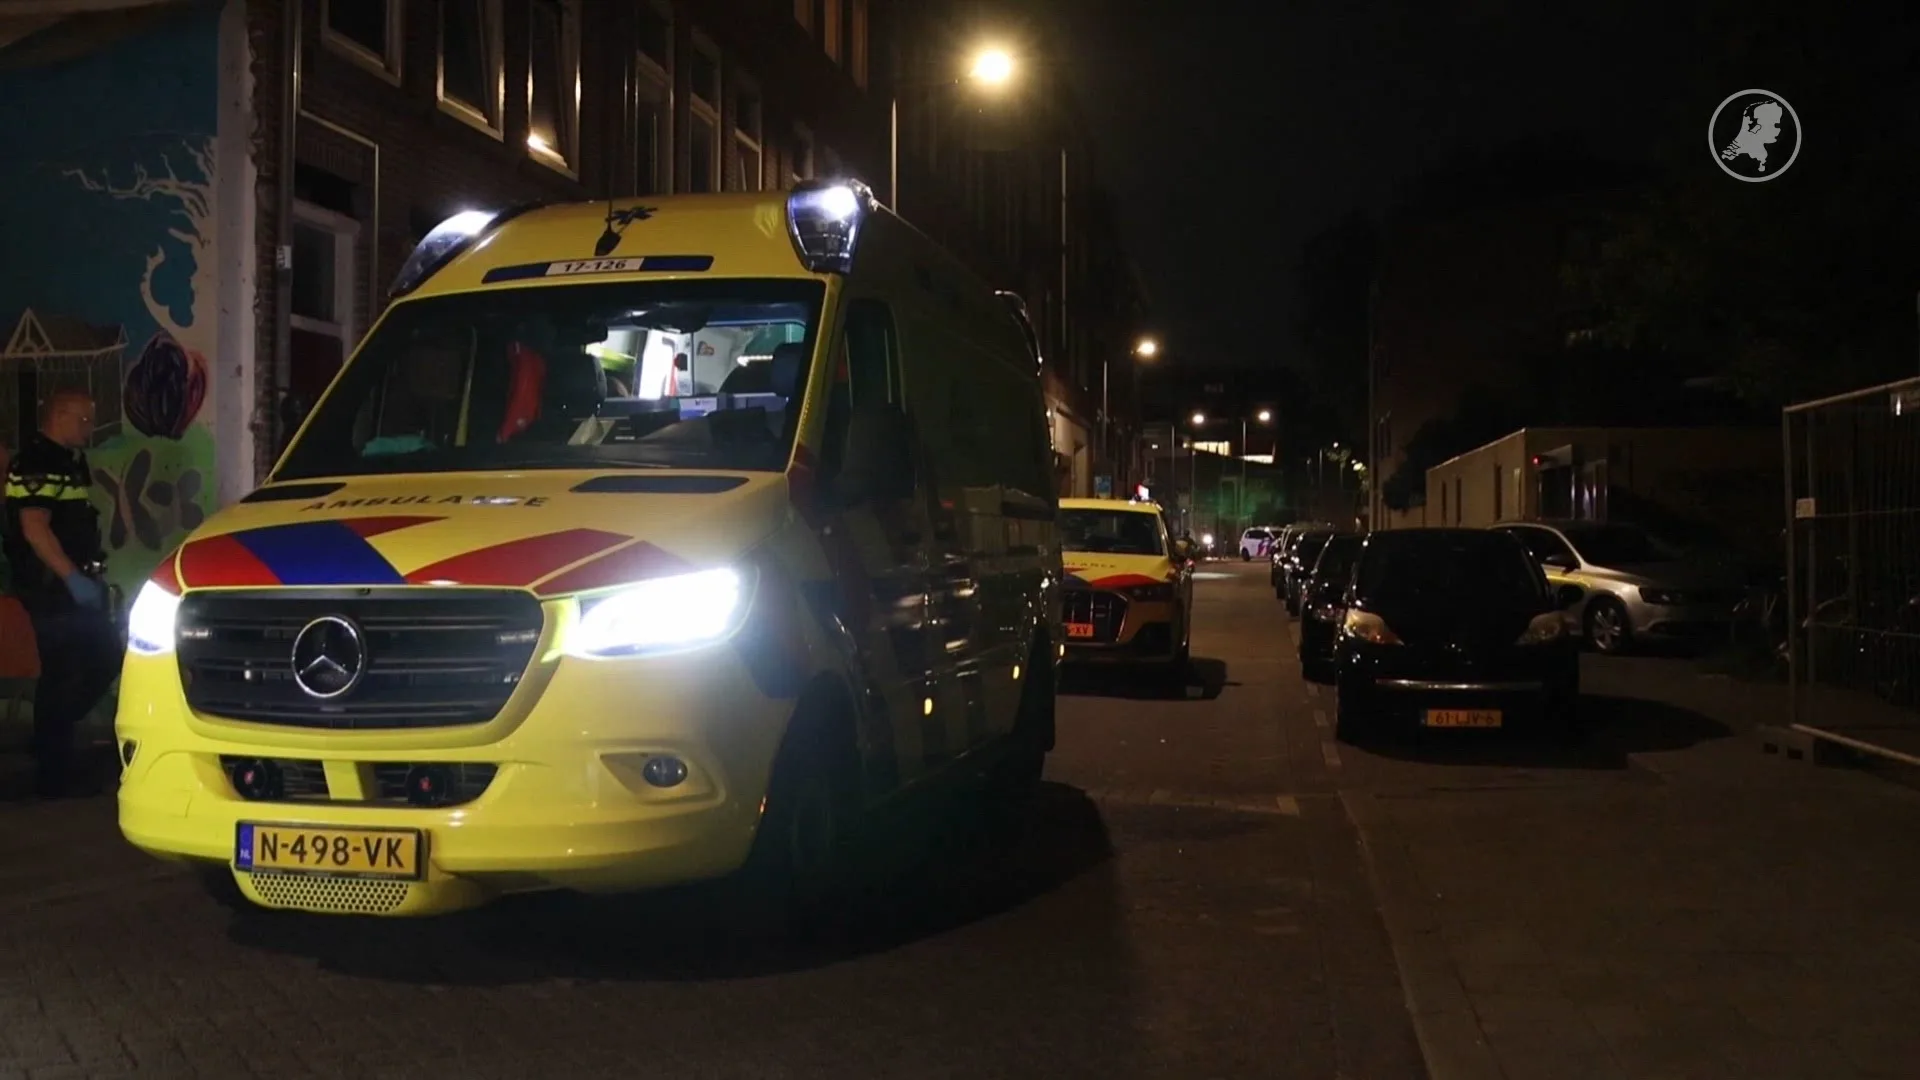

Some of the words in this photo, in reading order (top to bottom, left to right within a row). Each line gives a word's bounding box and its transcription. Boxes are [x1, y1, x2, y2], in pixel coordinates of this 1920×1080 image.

[563, 259, 627, 273] 17-126
[239, 848, 251, 860] NL
[260, 832, 405, 868] N-498-VK
